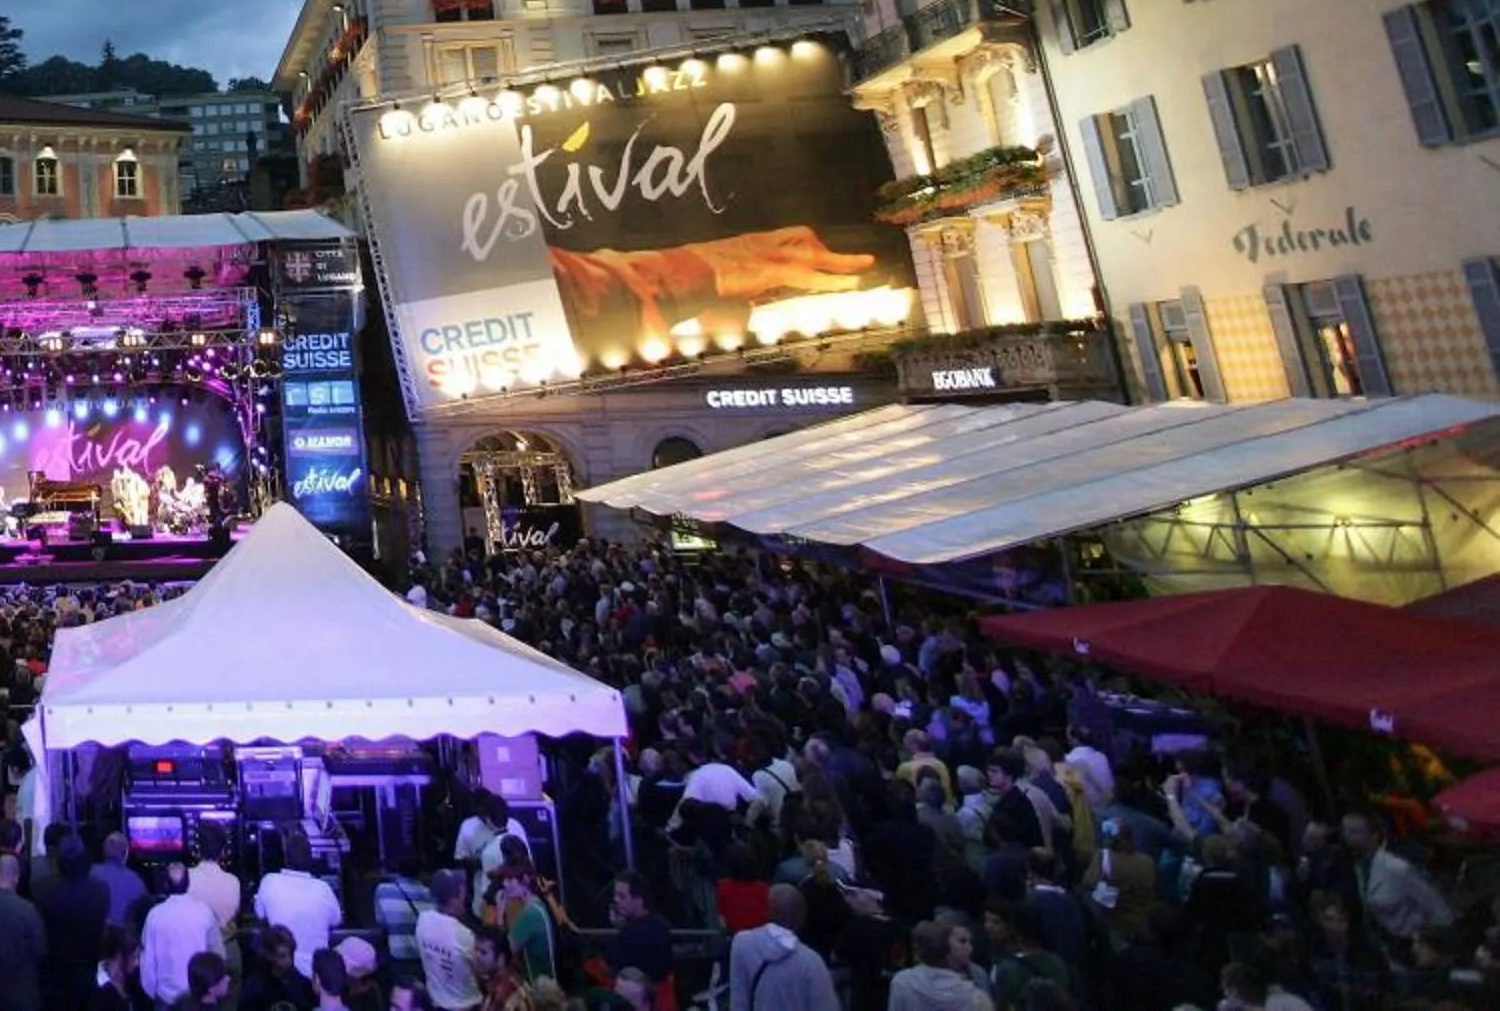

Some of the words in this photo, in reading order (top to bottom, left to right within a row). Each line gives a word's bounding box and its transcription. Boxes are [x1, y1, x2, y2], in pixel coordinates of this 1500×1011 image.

[462, 101, 737, 261] estival
[282, 332, 349, 351] CREDIT
[420, 311, 535, 356] CREDIT
[282, 350, 352, 369] SUISSE
[427, 342, 542, 387] SUISS
[706, 389, 778, 409] CREDIT
[781, 387, 853, 407] SUISSE
